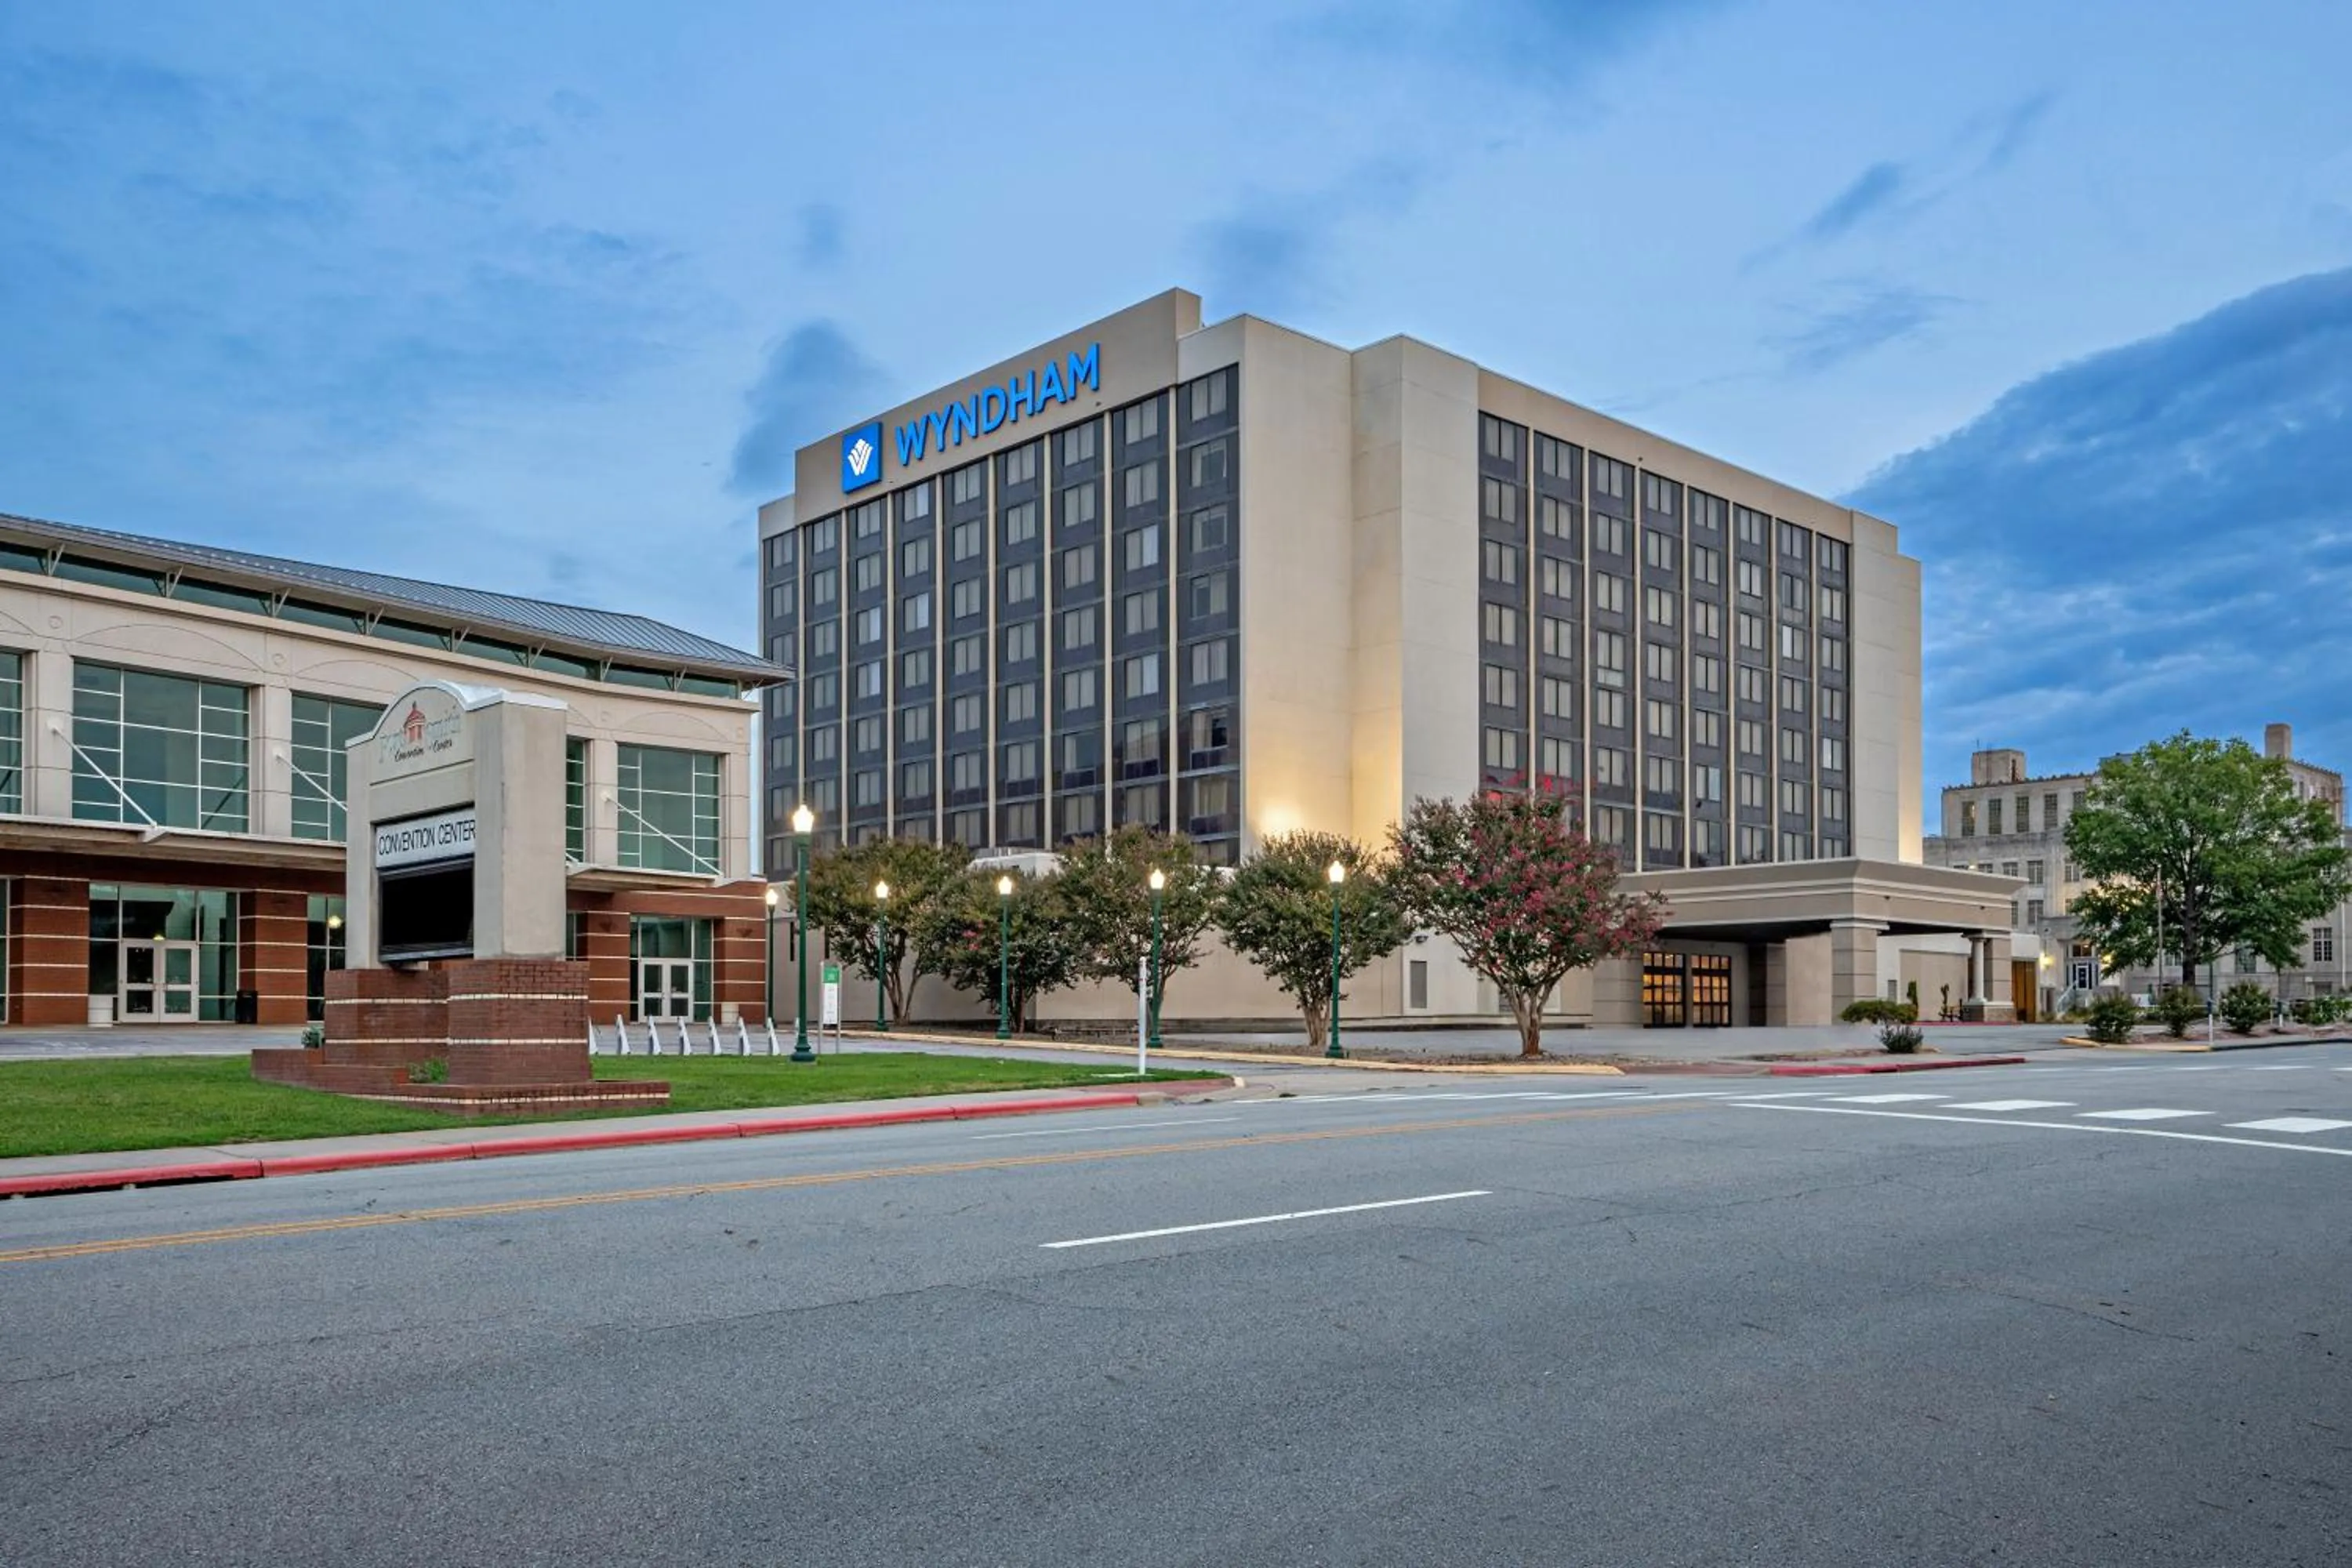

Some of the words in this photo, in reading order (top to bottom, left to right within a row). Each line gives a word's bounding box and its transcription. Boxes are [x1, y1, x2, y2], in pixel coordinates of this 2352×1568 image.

[895, 343, 1101, 466] WYNDHAM
[379, 827, 435, 855] CONVENTION
[439, 819, 476, 845] CENTER
